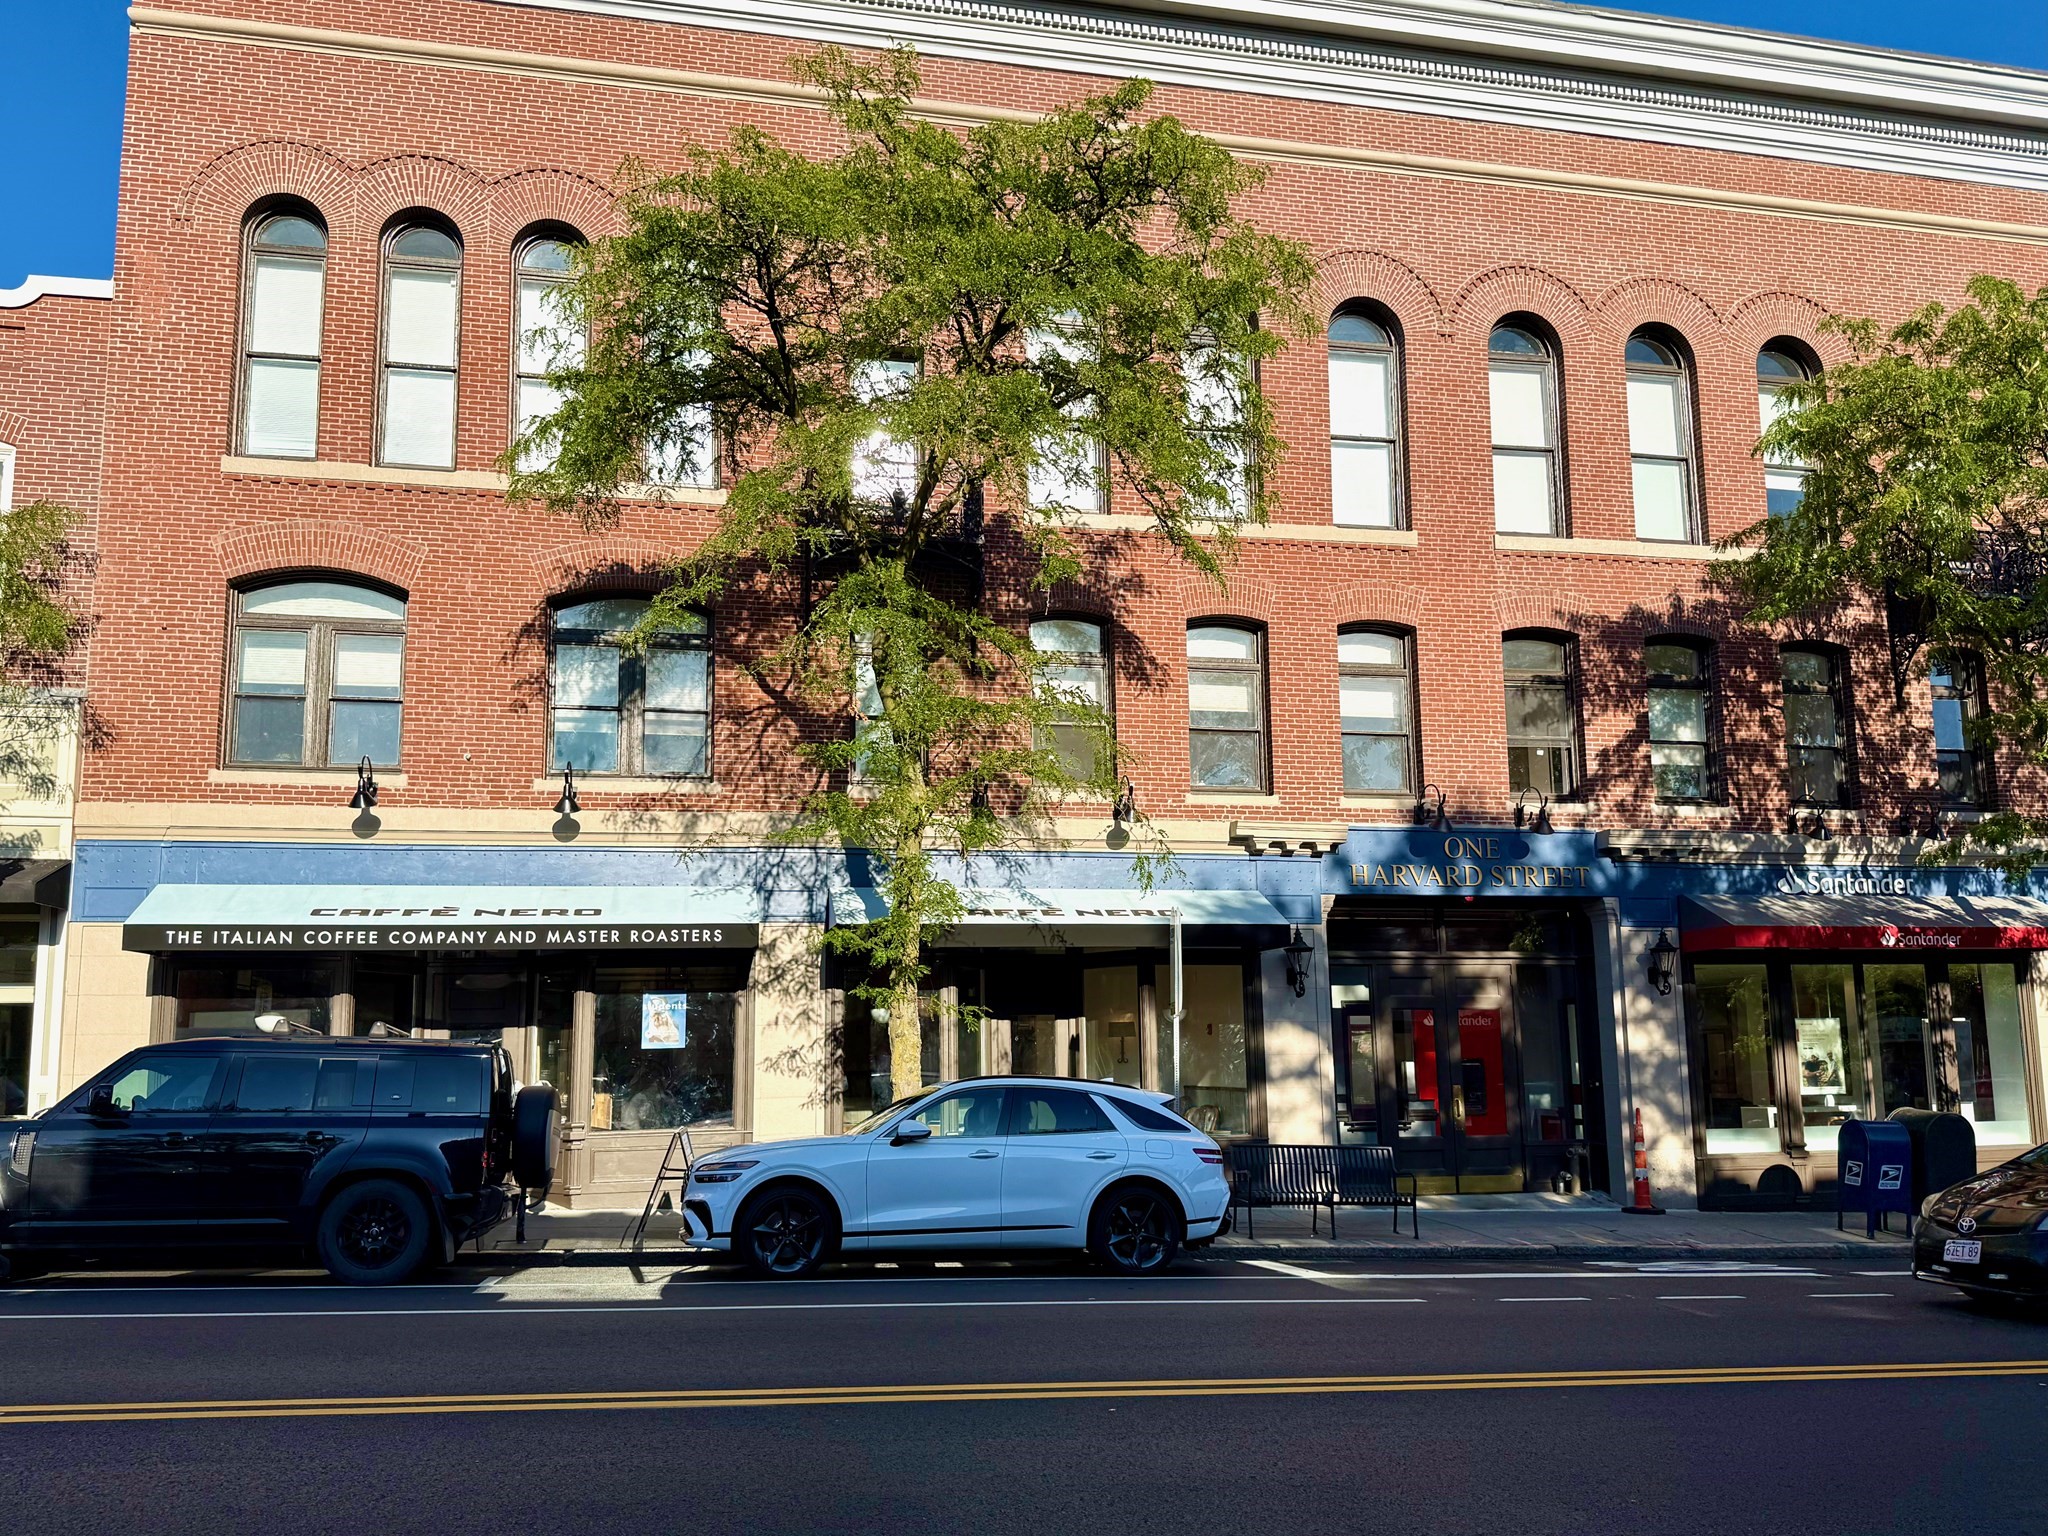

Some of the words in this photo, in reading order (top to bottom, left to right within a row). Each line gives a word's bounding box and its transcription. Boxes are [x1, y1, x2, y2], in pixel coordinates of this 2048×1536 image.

[1444, 837, 1500, 859] ONE
[1350, 864, 1483, 887] HARVARD
[1491, 865, 1590, 888] STREET
[1808, 872, 1914, 895] Santander
[310, 906, 459, 917] CAFFÈ
[473, 908, 602, 917] NERO
[967, 906, 1065, 917] AFFÈ
[166, 930, 203, 945] THE
[213, 930, 293, 945] ITALIAN
[303, 930, 378, 945] COFFEE
[388, 930, 488, 945] COMPANY
[494, 929, 537, 944] AND
[546, 929, 620, 943] MASTER
[630, 928, 723, 943] ROASTERS
[1898, 932, 1962, 946] Santander
[1458, 1015, 1492, 1026] tander
[1968, 1246, 1979, 1258] 89
